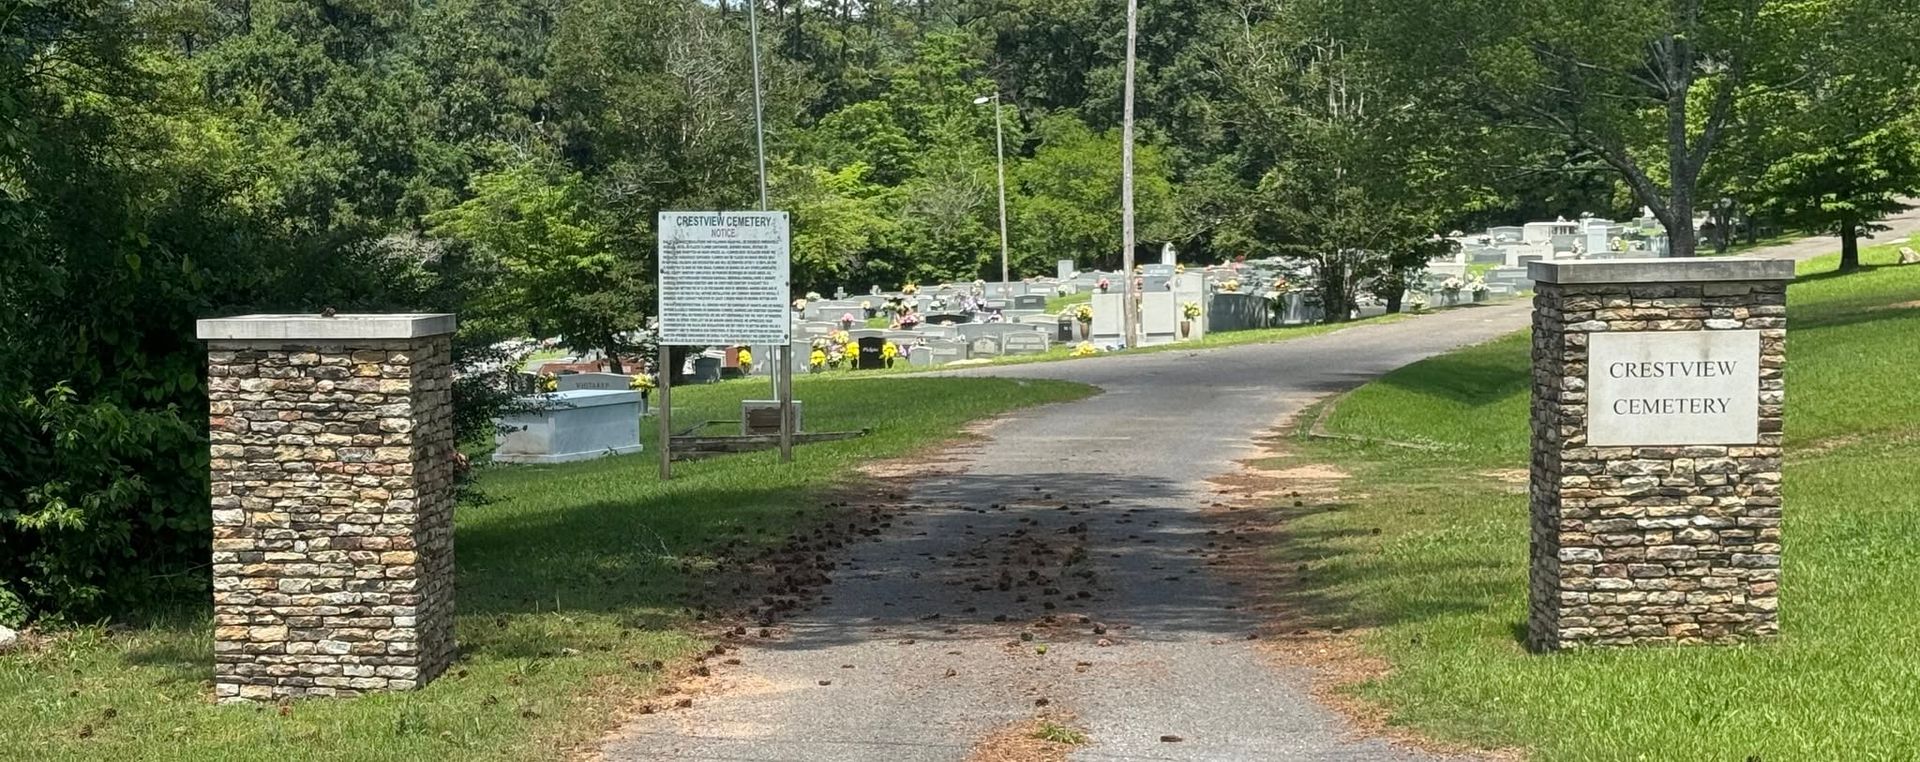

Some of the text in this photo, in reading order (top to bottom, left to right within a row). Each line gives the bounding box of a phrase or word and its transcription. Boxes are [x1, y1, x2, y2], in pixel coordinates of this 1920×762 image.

[676, 215, 772, 227] CRESTVIEW CEMETERY
[711, 228, 736, 238] NOTICE
[1609, 360, 1738, 379] CRESTVIEW
[1612, 397, 1732, 415] CEMETERY
